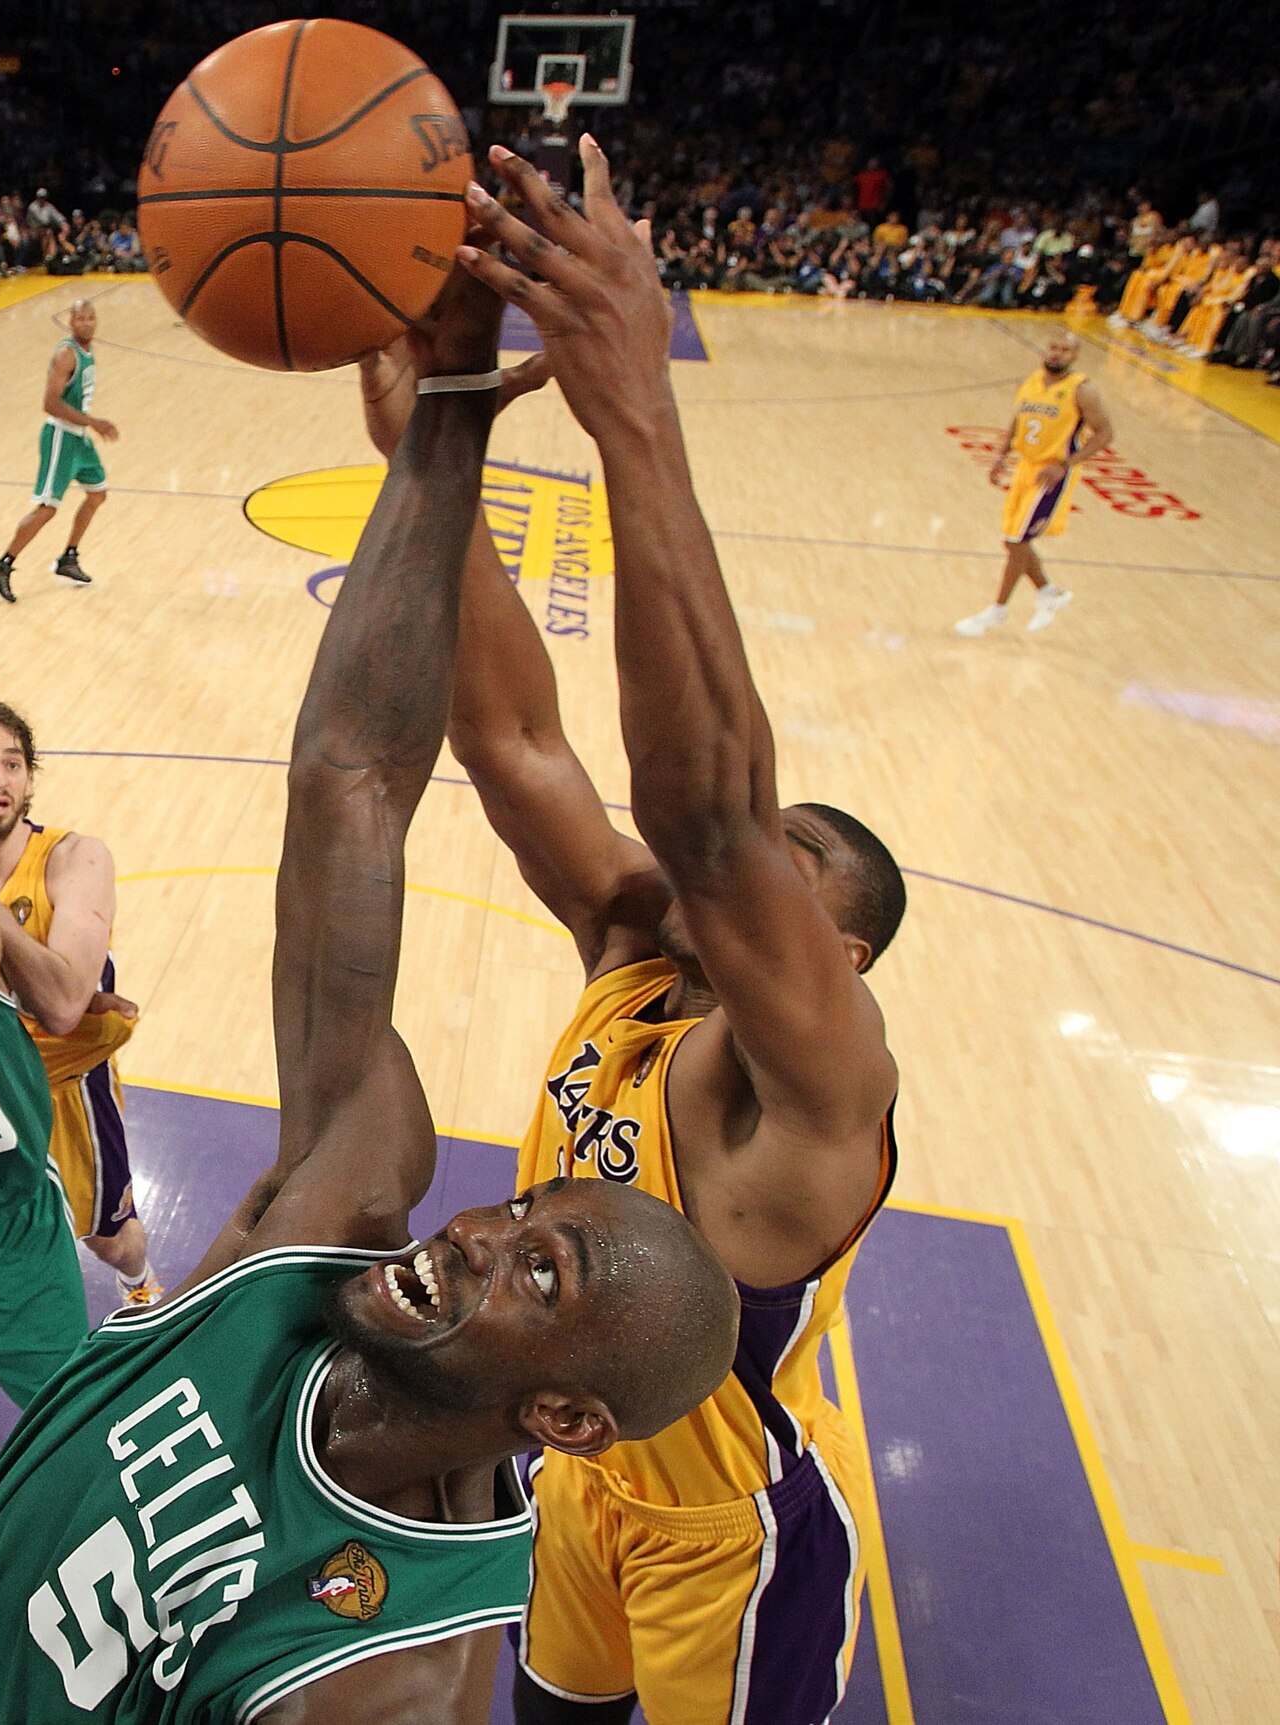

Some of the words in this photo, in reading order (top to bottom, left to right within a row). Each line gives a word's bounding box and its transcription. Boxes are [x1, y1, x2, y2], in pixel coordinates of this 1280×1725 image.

[1024, 419, 1042, 446] 2
[558, 495, 592, 528] LOS
[545, 529, 590, 640] ANGELES
[107, 1377, 266, 1692] CELTICS
[27, 1515, 160, 1712] 5
